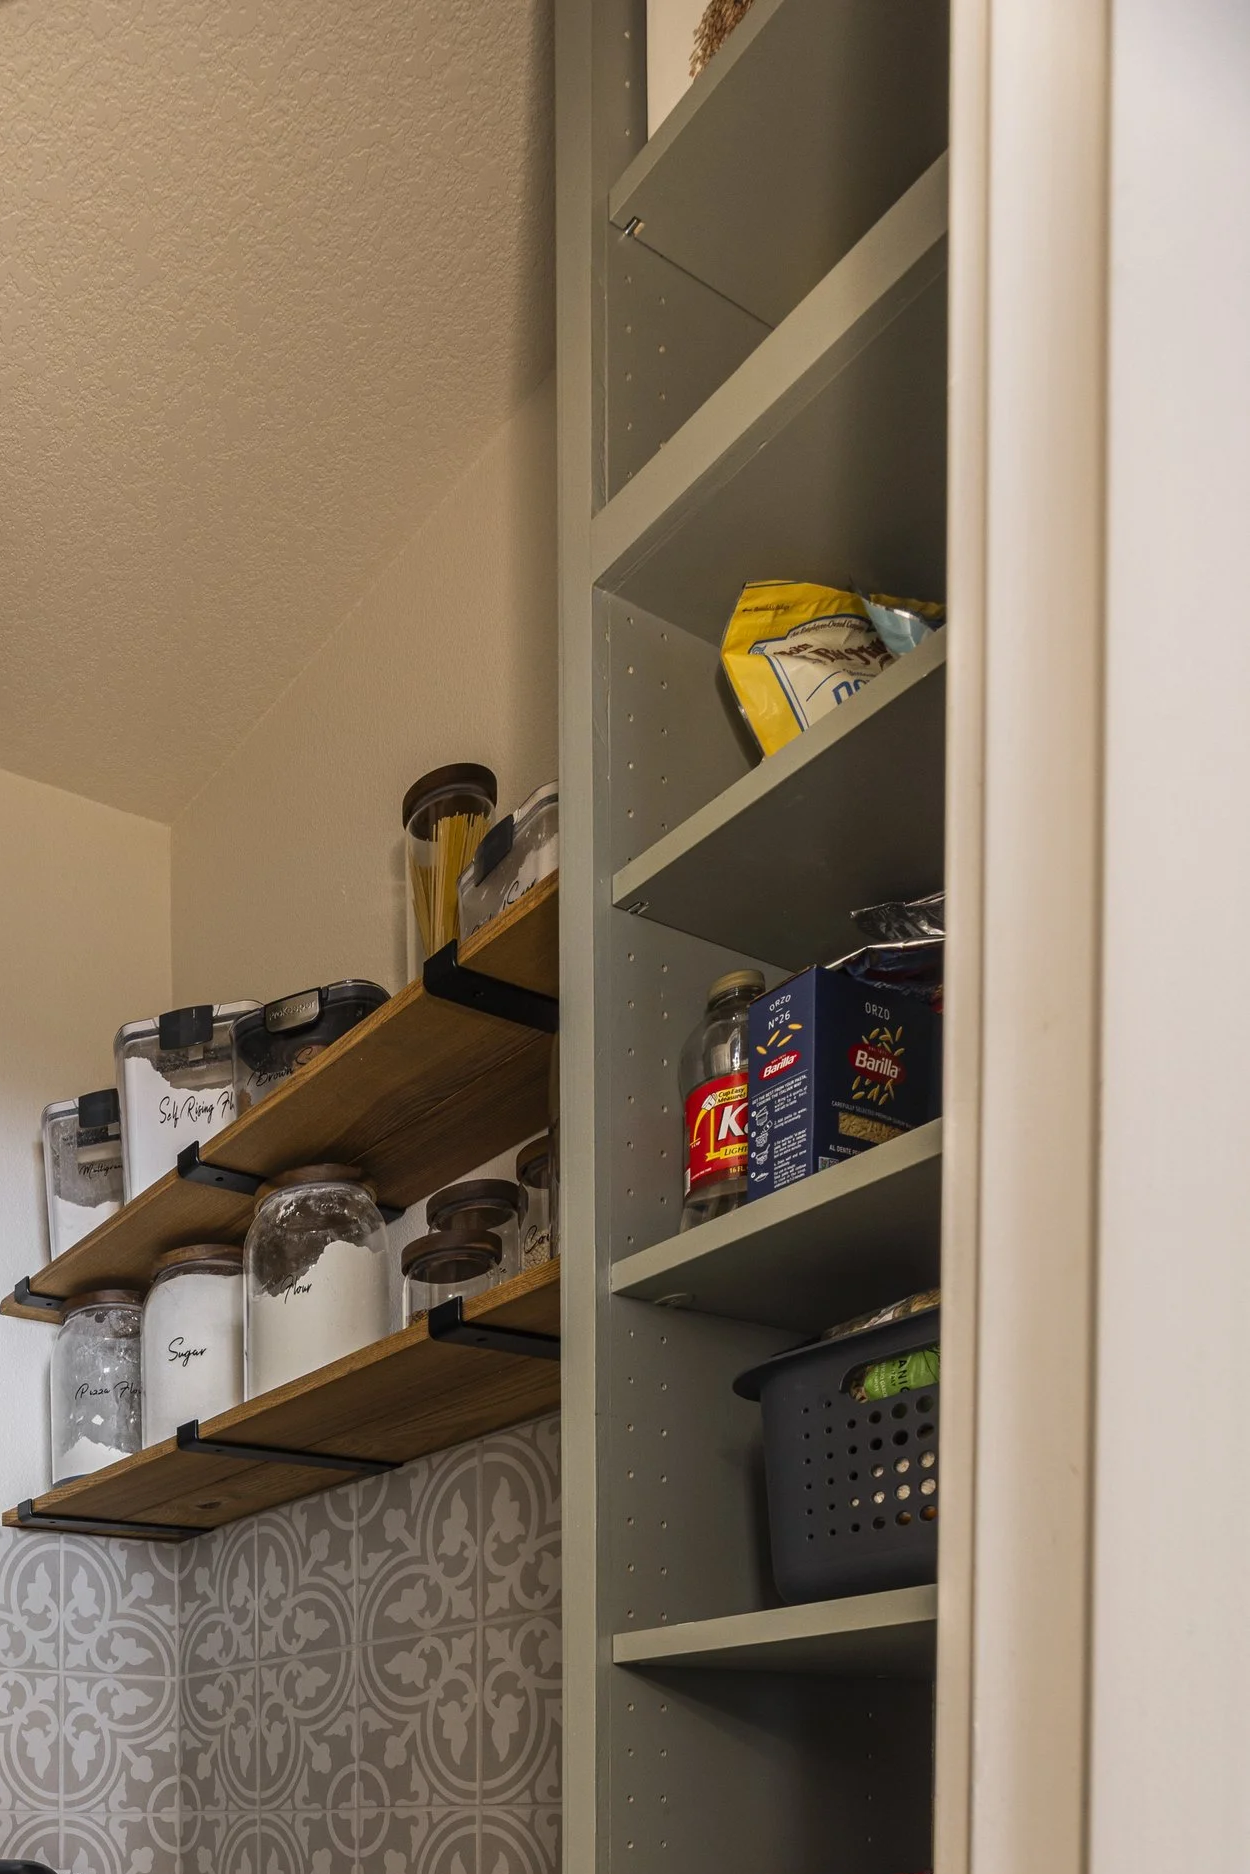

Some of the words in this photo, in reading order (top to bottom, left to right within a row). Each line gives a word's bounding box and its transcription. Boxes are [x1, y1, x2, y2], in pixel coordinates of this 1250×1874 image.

[769, 994, 792, 1013] ORZO
[865, 1002, 890, 1021] ORZO
[763, 1054, 798, 1078] Barilla
[855, 1049, 898, 1078] Barilla
[249, 1067, 293, 1088] Brown
[718, 1091, 731, 1099] Cup
[731, 1087, 746, 1097] Easy
[159, 1096, 180, 1128] Self
[179, 1096, 214, 1124] Rising
[829, 1144, 835, 1152] AL
[836, 1145, 851, 1155] DENTE
[282, 1275, 313, 1304] Flour
[168, 1337, 207, 1367] Sugar
[75, 1383, 111, 1400] Pizza
